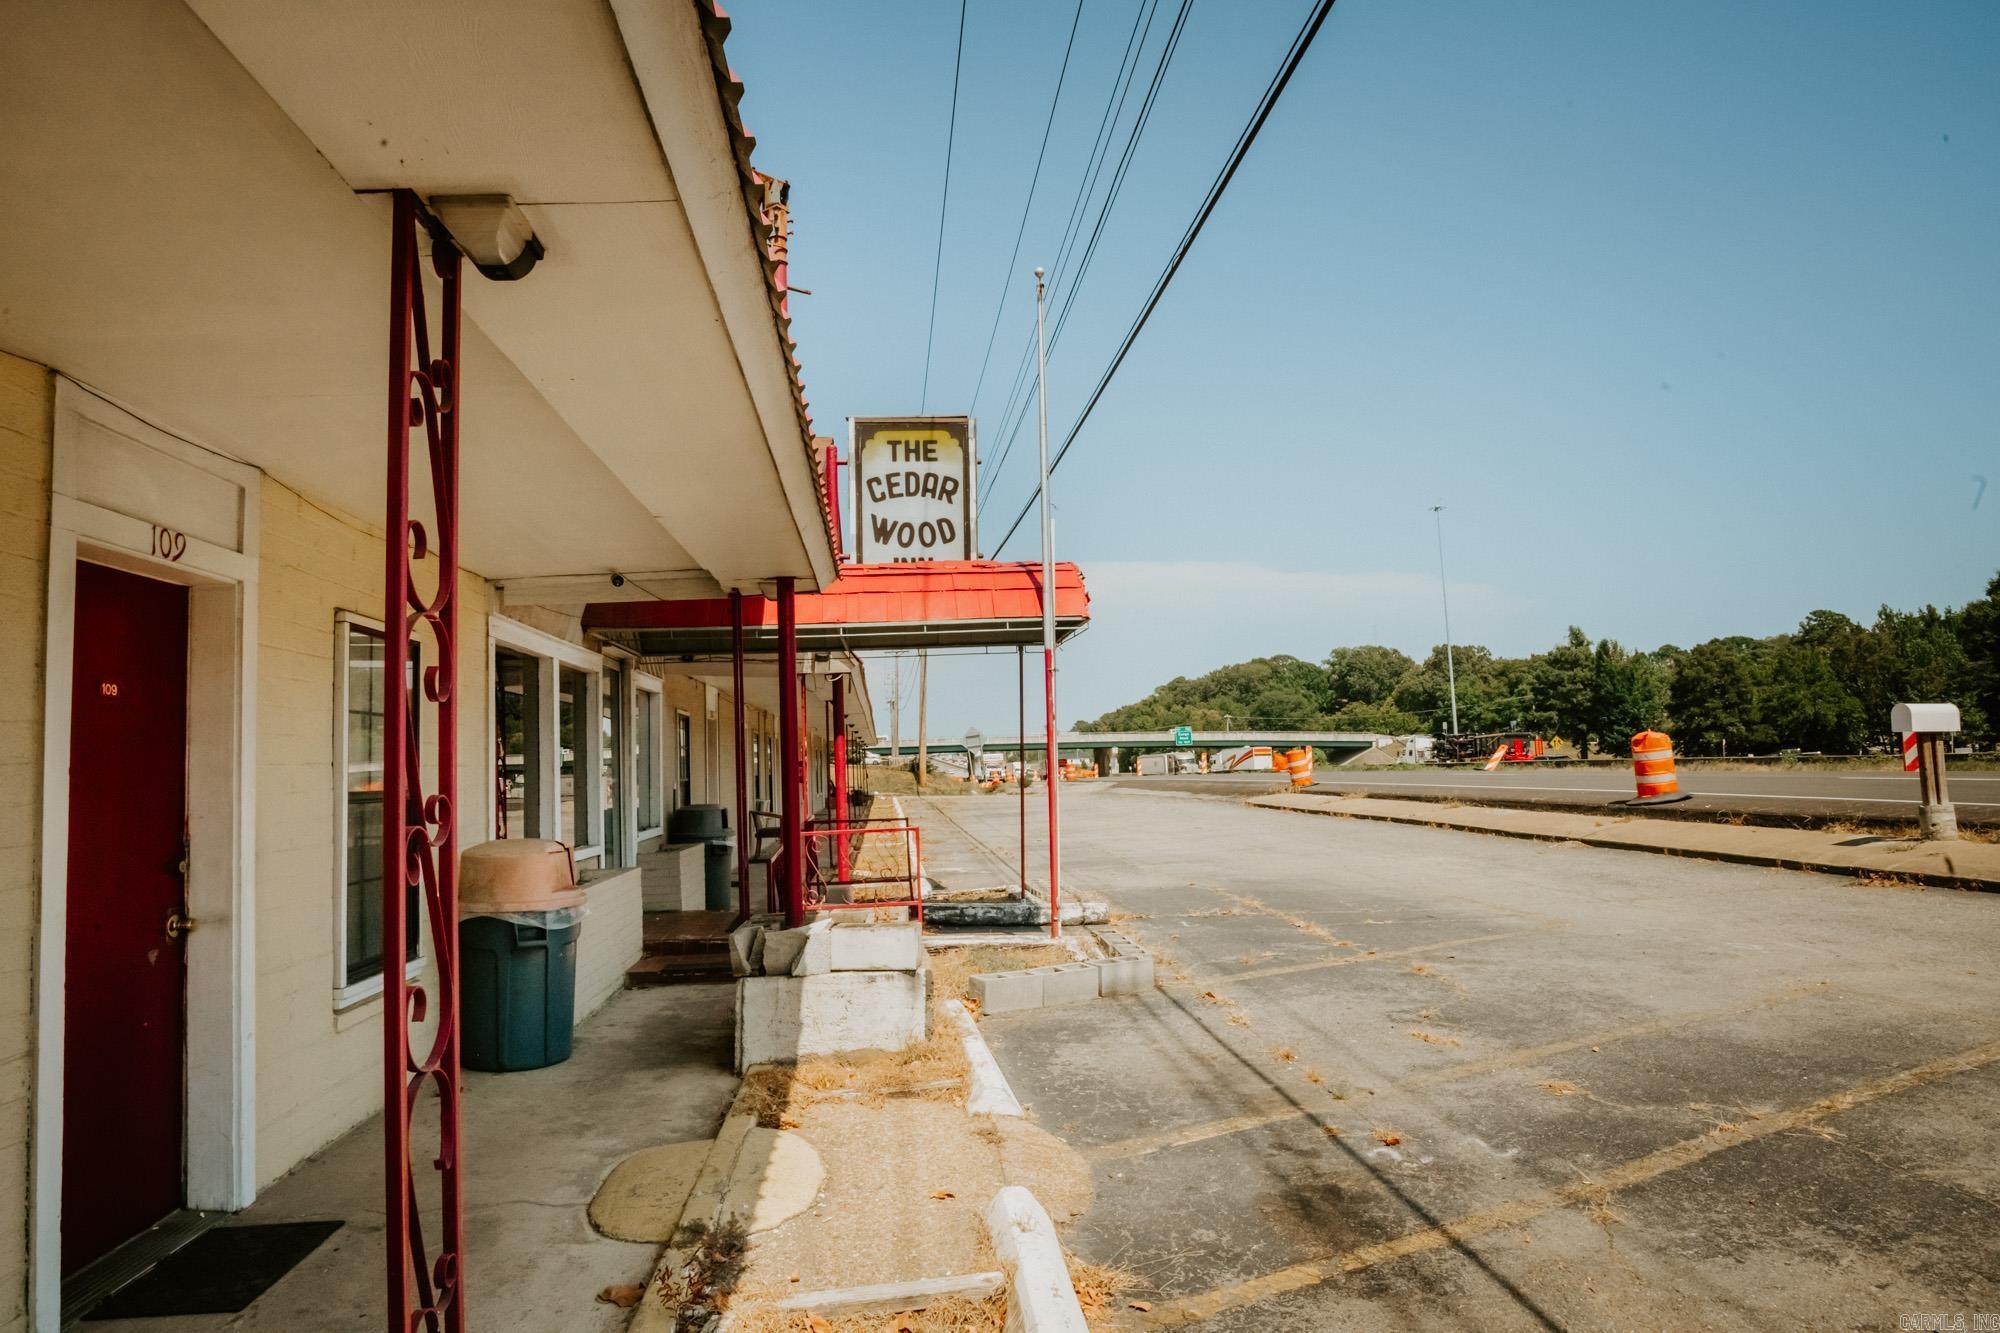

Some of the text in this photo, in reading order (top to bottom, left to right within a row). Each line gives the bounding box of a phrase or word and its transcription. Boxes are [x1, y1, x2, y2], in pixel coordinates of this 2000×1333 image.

[886, 440, 938, 462] THE
[866, 471, 959, 504] CEDAR
[152, 524, 186, 562] 109
[871, 513, 956, 548] WOOD
[102, 683, 118, 696] 109
